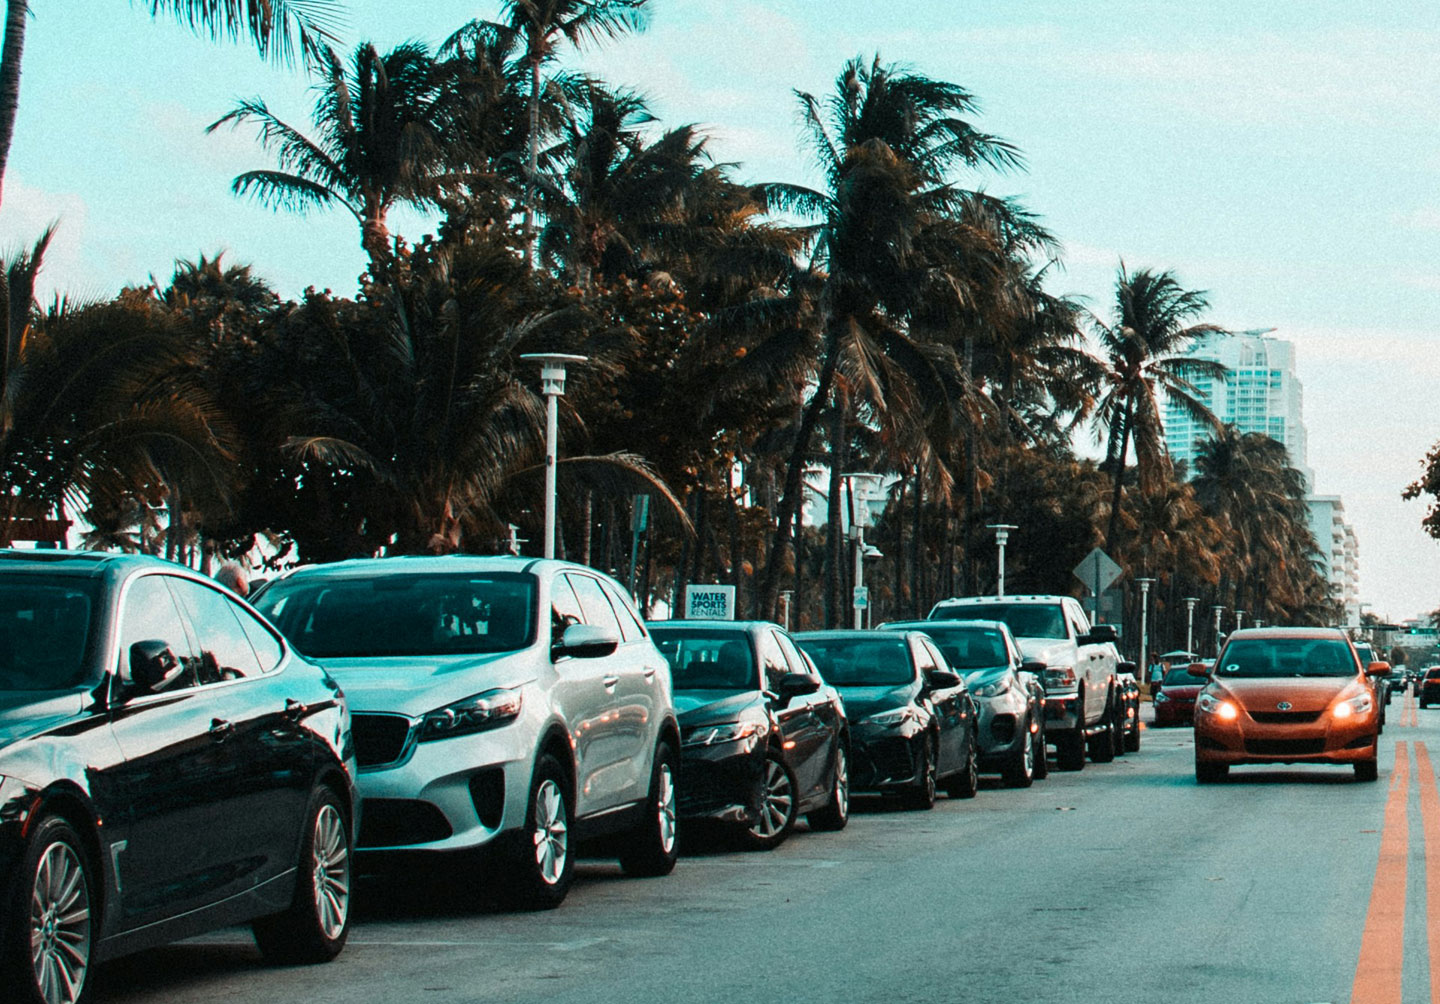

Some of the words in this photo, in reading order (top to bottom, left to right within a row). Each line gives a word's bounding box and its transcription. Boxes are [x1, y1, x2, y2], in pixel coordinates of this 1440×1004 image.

[692, 592, 727, 601] WATER
[692, 601, 727, 609] SPORTS
[691, 608, 727, 617] RENTALS
